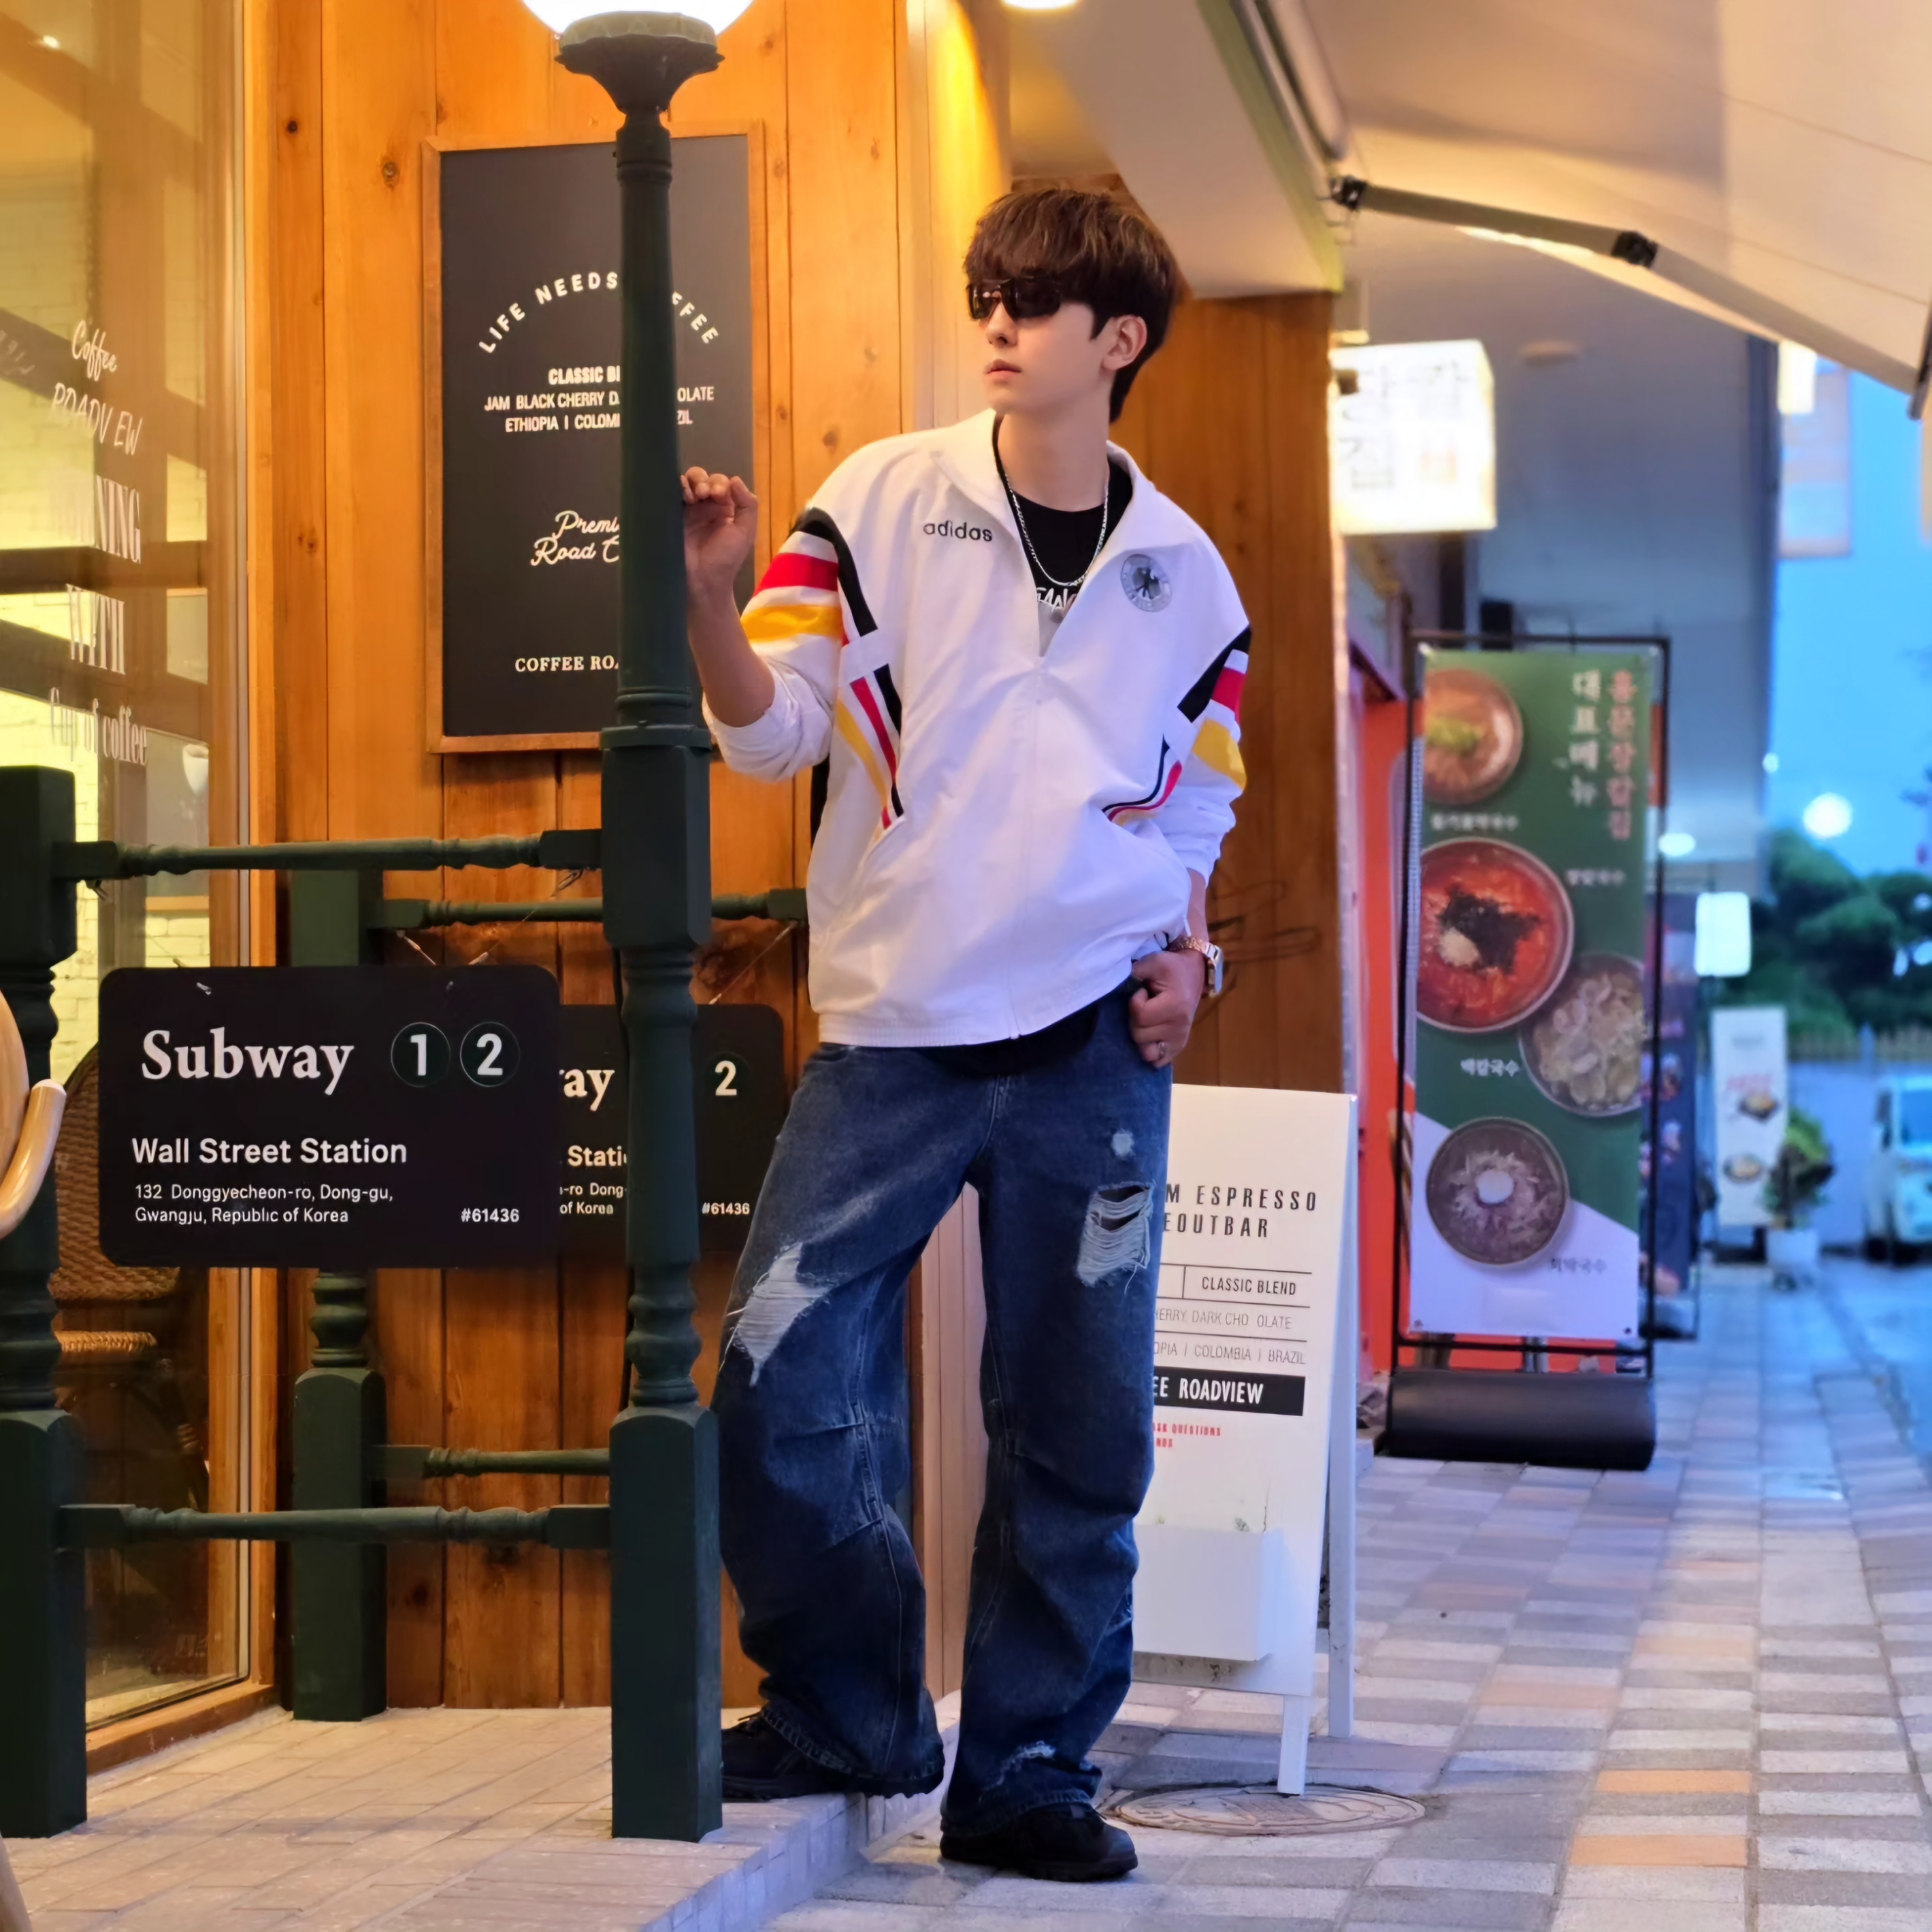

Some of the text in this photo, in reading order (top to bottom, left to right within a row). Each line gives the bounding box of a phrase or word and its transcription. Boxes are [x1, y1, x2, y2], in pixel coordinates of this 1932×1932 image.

[478, 302, 526, 353] LIFE
[534, 272, 619, 305] NEEDS
[72, 320, 118, 381] Coffee
[548, 366, 604, 385] CLASSIC
[484, 395, 510, 411] JAM
[516, 393, 555, 410] BLACK
[557, 391, 604, 408] CHERRY
[505, 415, 559, 432] ETHIOPIA
[923, 520, 993, 542] adidas
[530, 536, 596, 566] Road
[514, 655, 619, 672] COFFEE RO
[103, 705, 147, 766] coffee
[142, 1027, 503, 1095] Subway 1 2
[715, 1060, 737, 1096] 2
[132, 1138, 407, 1164] Wall Street Station
[135, 1184, 393, 1202] 132 Donggyecheon-ro, Dong-gu,
[1196, 1185, 1316, 1211] ESPRESSO
[135, 1207, 348, 1225] Gwangju, Republic of Korea
[461, 1207, 520, 1223] #61436
[576, 1201, 614, 1214] Korea
[702, 1202, 751, 1215] #61436
[1202, 1276, 1296, 1296] CLASSIC BLEND
[1192, 1311, 1221, 1324] DARK
[1194, 1345, 1251, 1360] COLOMBIA
[1268, 1349, 1306, 1364] BRAZIL
[1179, 1378, 1264, 1404] ROADVIEW
